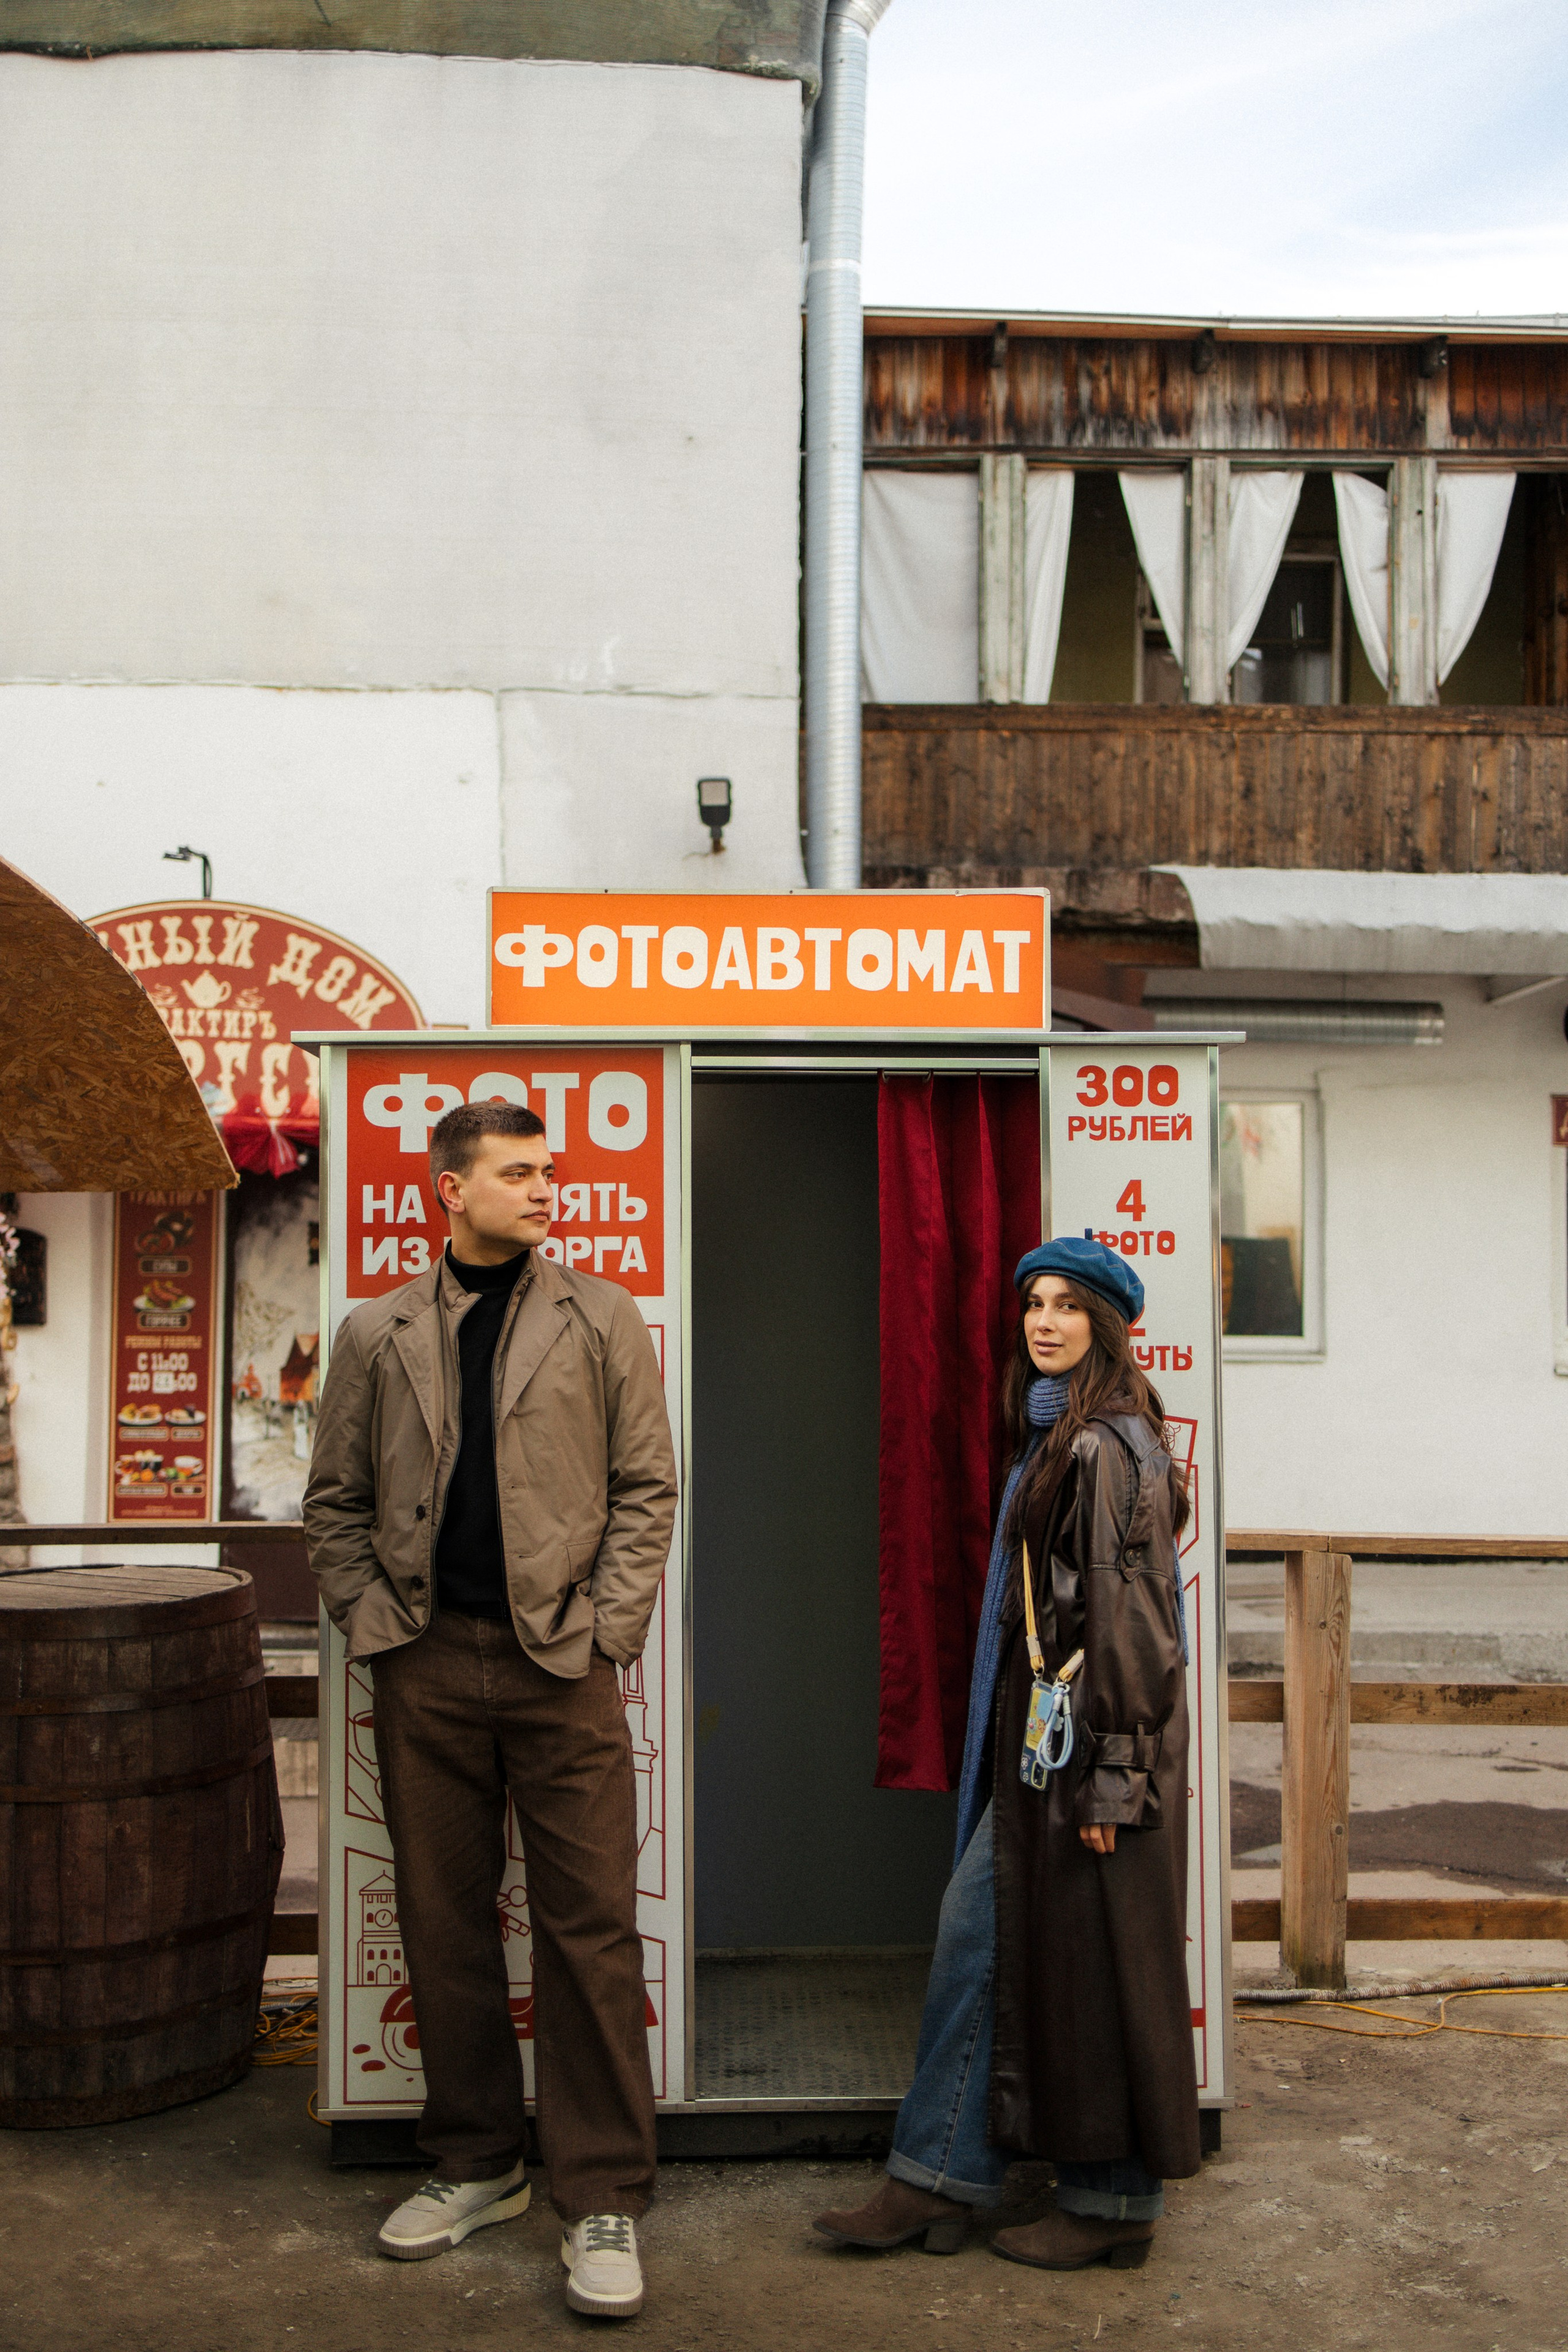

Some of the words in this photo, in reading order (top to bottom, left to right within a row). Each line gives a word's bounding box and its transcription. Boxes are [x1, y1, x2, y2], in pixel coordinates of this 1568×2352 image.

[97, 913, 260, 971] НЫЙ
[266, 932, 396, 1030] ДОМ
[494, 924, 1030, 993] ФОТОАВТОМАТ
[157, 1006, 277, 1040] АКТИРЪ
[1076, 1065, 1179, 1107] 300
[1068, 1113, 1192, 1141] РУБЛЕЙ
[363, 1184, 427, 1224] НА
[551, 1182, 647, 1222] ЯТЬ
[1116, 1180, 1146, 1222] 4
[363, 1237, 431, 1275] ИЗ
[137, 1352, 148, 1371] С
[1130, 1345, 1193, 1371] УТЫ
[127, 1371, 151, 1394] ДО
